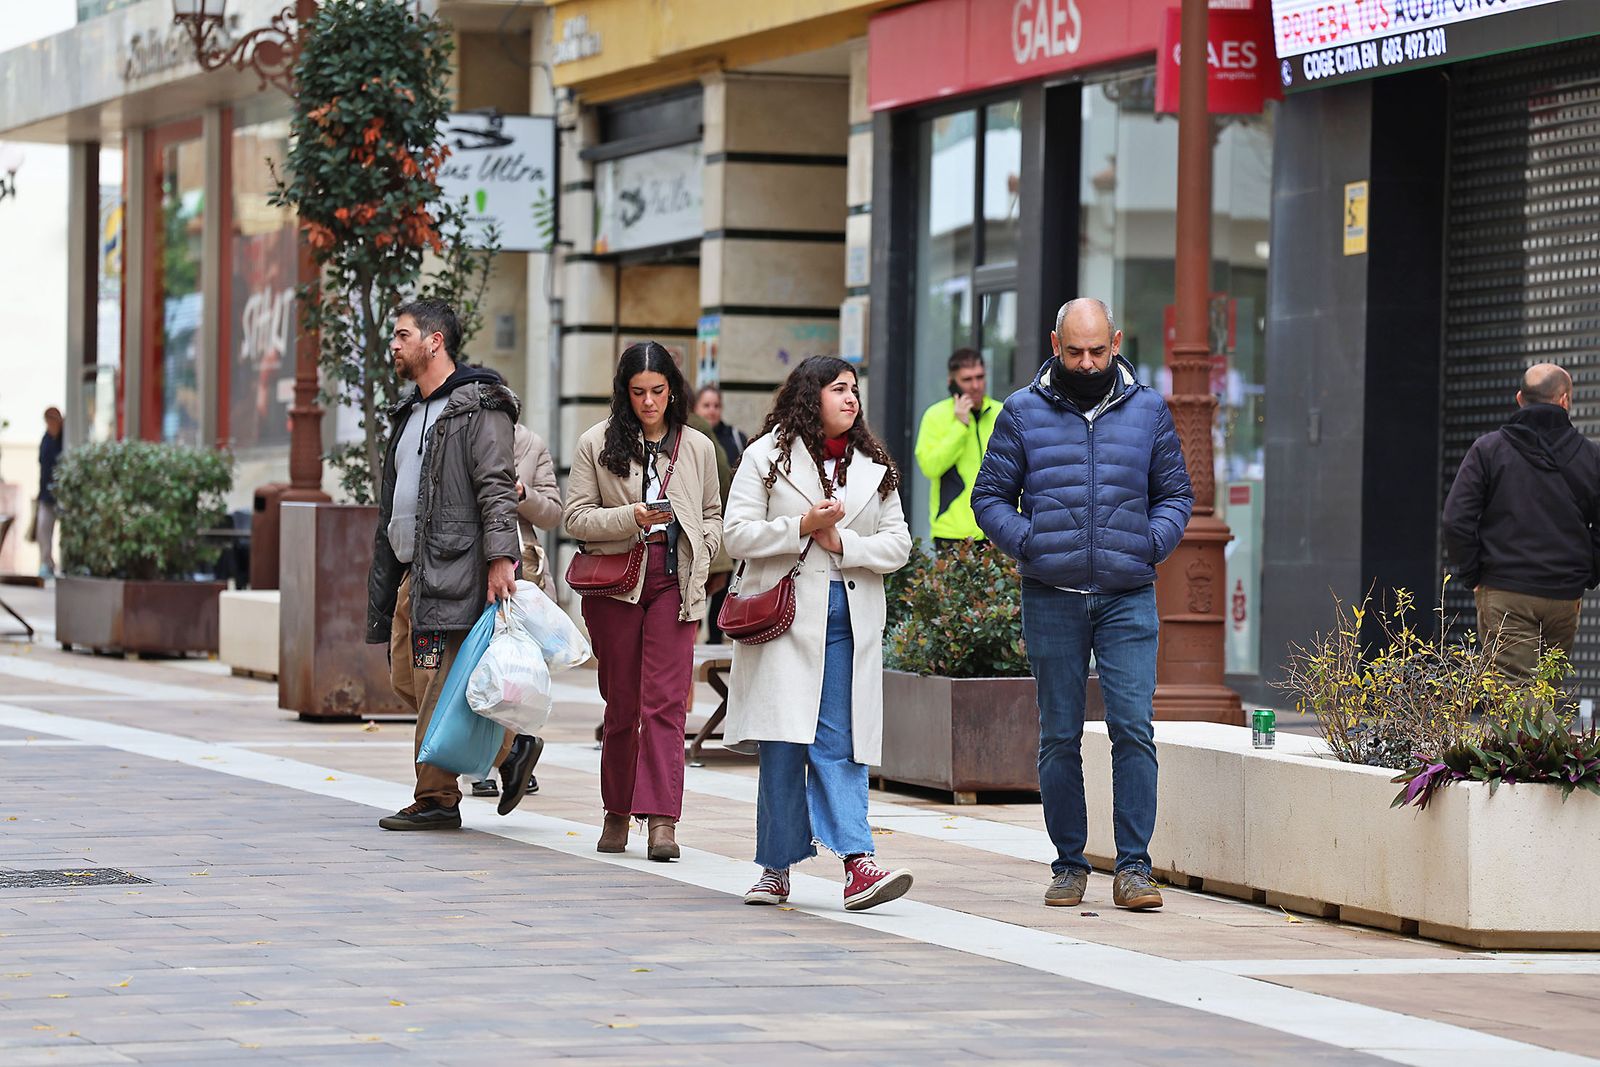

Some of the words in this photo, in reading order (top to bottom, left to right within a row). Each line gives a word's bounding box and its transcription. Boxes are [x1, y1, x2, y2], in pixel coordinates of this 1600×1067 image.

[1011, 0, 1082, 65] GAES
[1354, 0, 1390, 36] TUS
[1303, 50, 1336, 80] COGE
[1335, 45, 1362, 74] CITA
[1360, 41, 1378, 69] EN
[1381, 37, 1403, 66] 603
[1404, 31, 1427, 60] 492
[1426, 27, 1447, 56] 201
